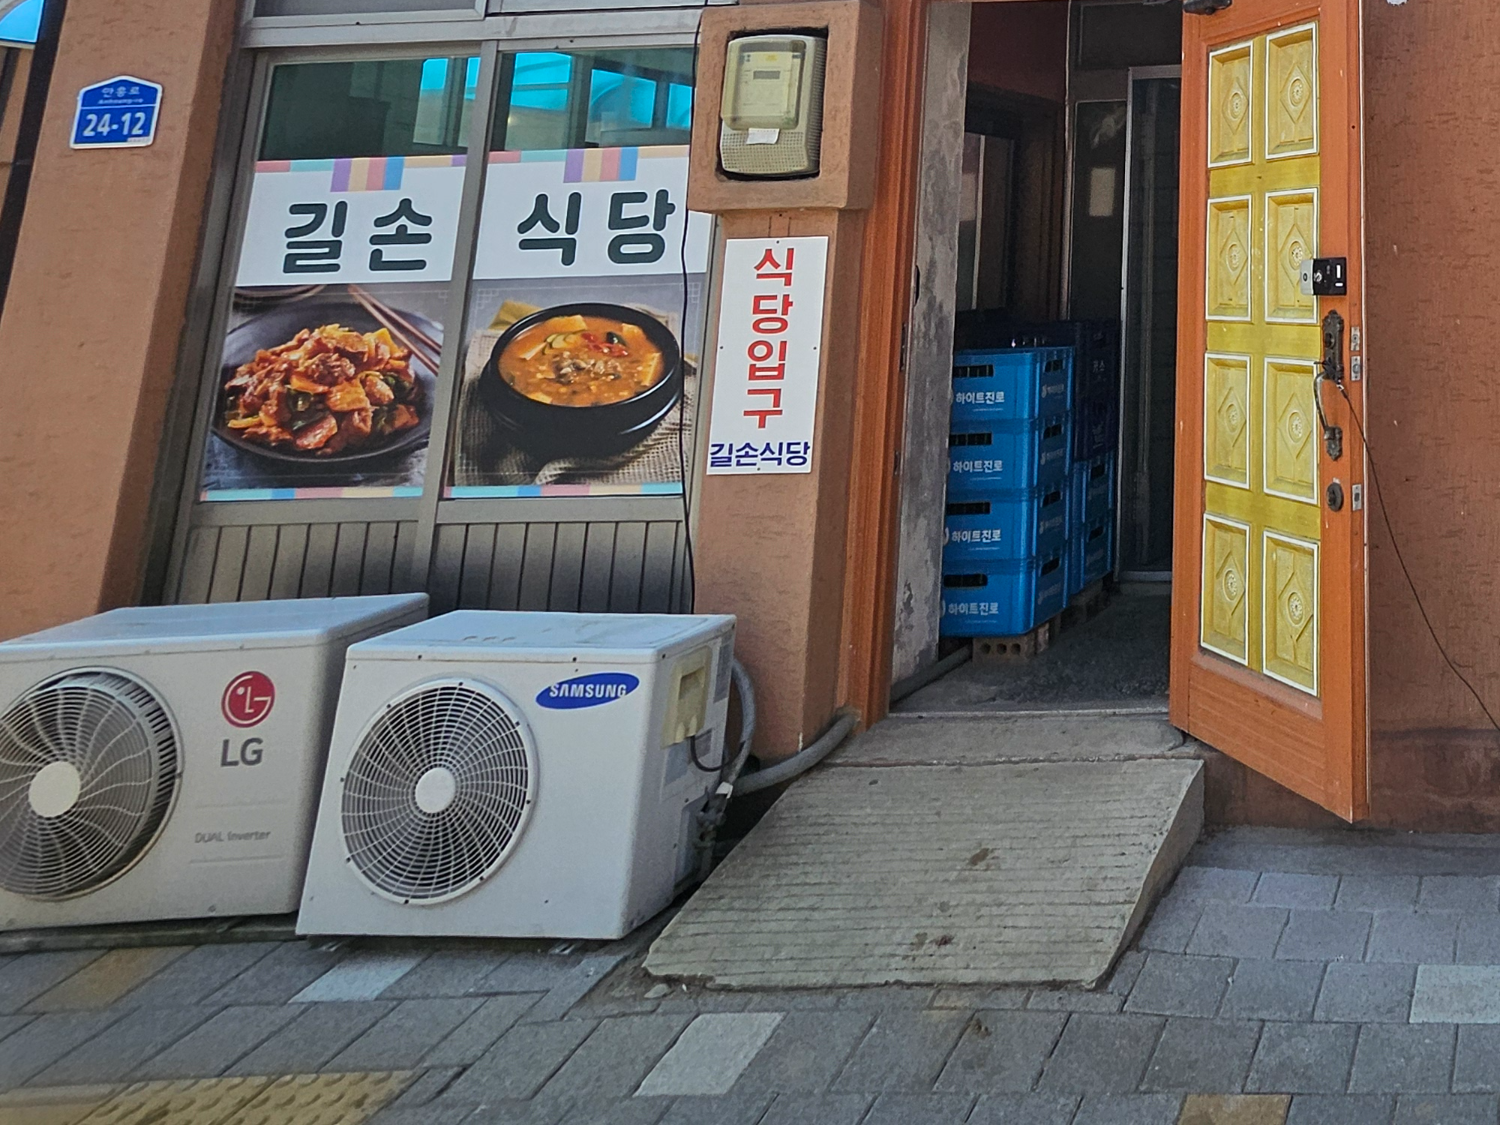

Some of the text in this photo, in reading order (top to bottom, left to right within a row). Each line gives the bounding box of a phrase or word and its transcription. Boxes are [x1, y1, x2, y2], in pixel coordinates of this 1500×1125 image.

[82, 112, 146, 136] 24-12
[282, 189, 676, 274] 길손 식당
[743, 247, 795, 429] 식당입구
[955, 391, 1005, 405] 하이트진로
[709, 441, 811, 468] 길손식당
[952, 460, 1003, 474] 하이트진로
[951, 528, 1002, 544] 하이트진로
[948, 601, 999, 616] 하이트진로
[548, 682, 628, 699] SAMSUNG
[220, 737, 264, 767] LG
